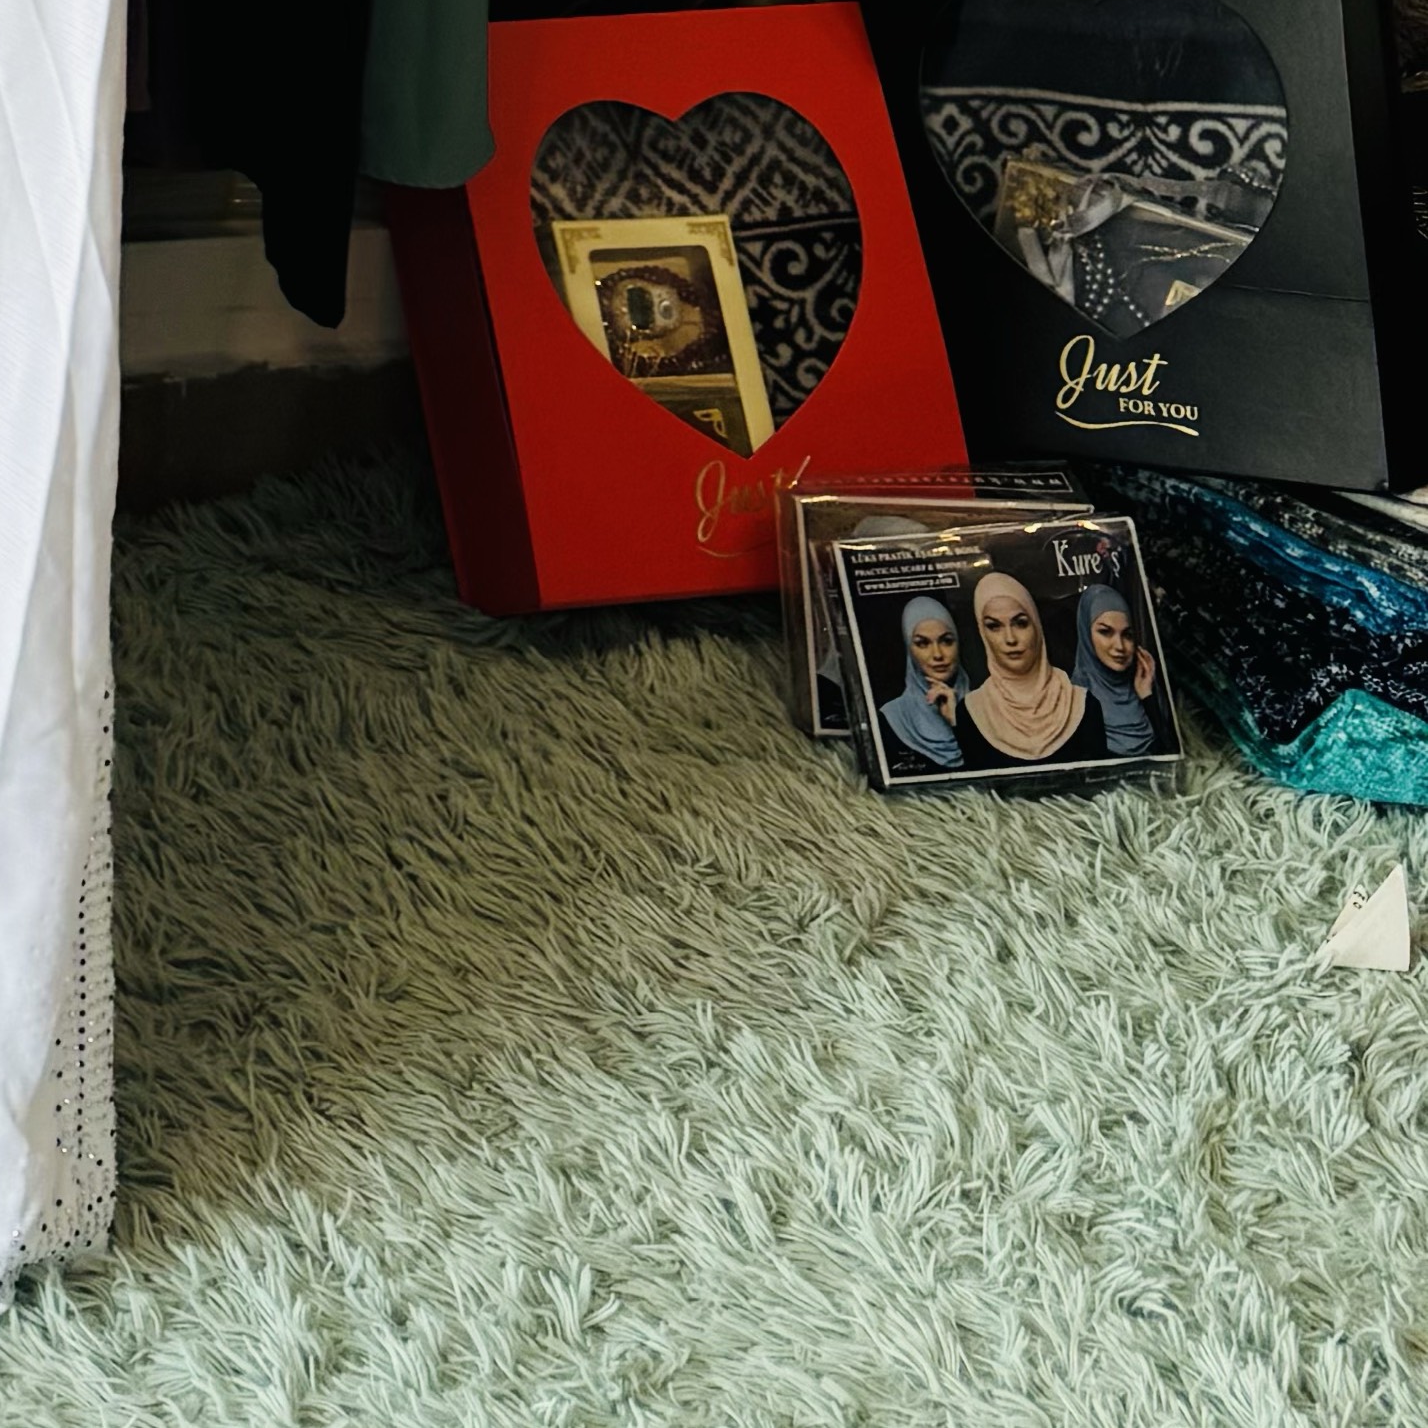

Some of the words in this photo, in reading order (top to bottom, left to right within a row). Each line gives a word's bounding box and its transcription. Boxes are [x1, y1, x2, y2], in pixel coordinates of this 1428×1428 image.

[1055, 334, 1169, 410] Just
[1118, 397, 1156, 417] FOR
[1157, 402, 1199, 421] YOU
